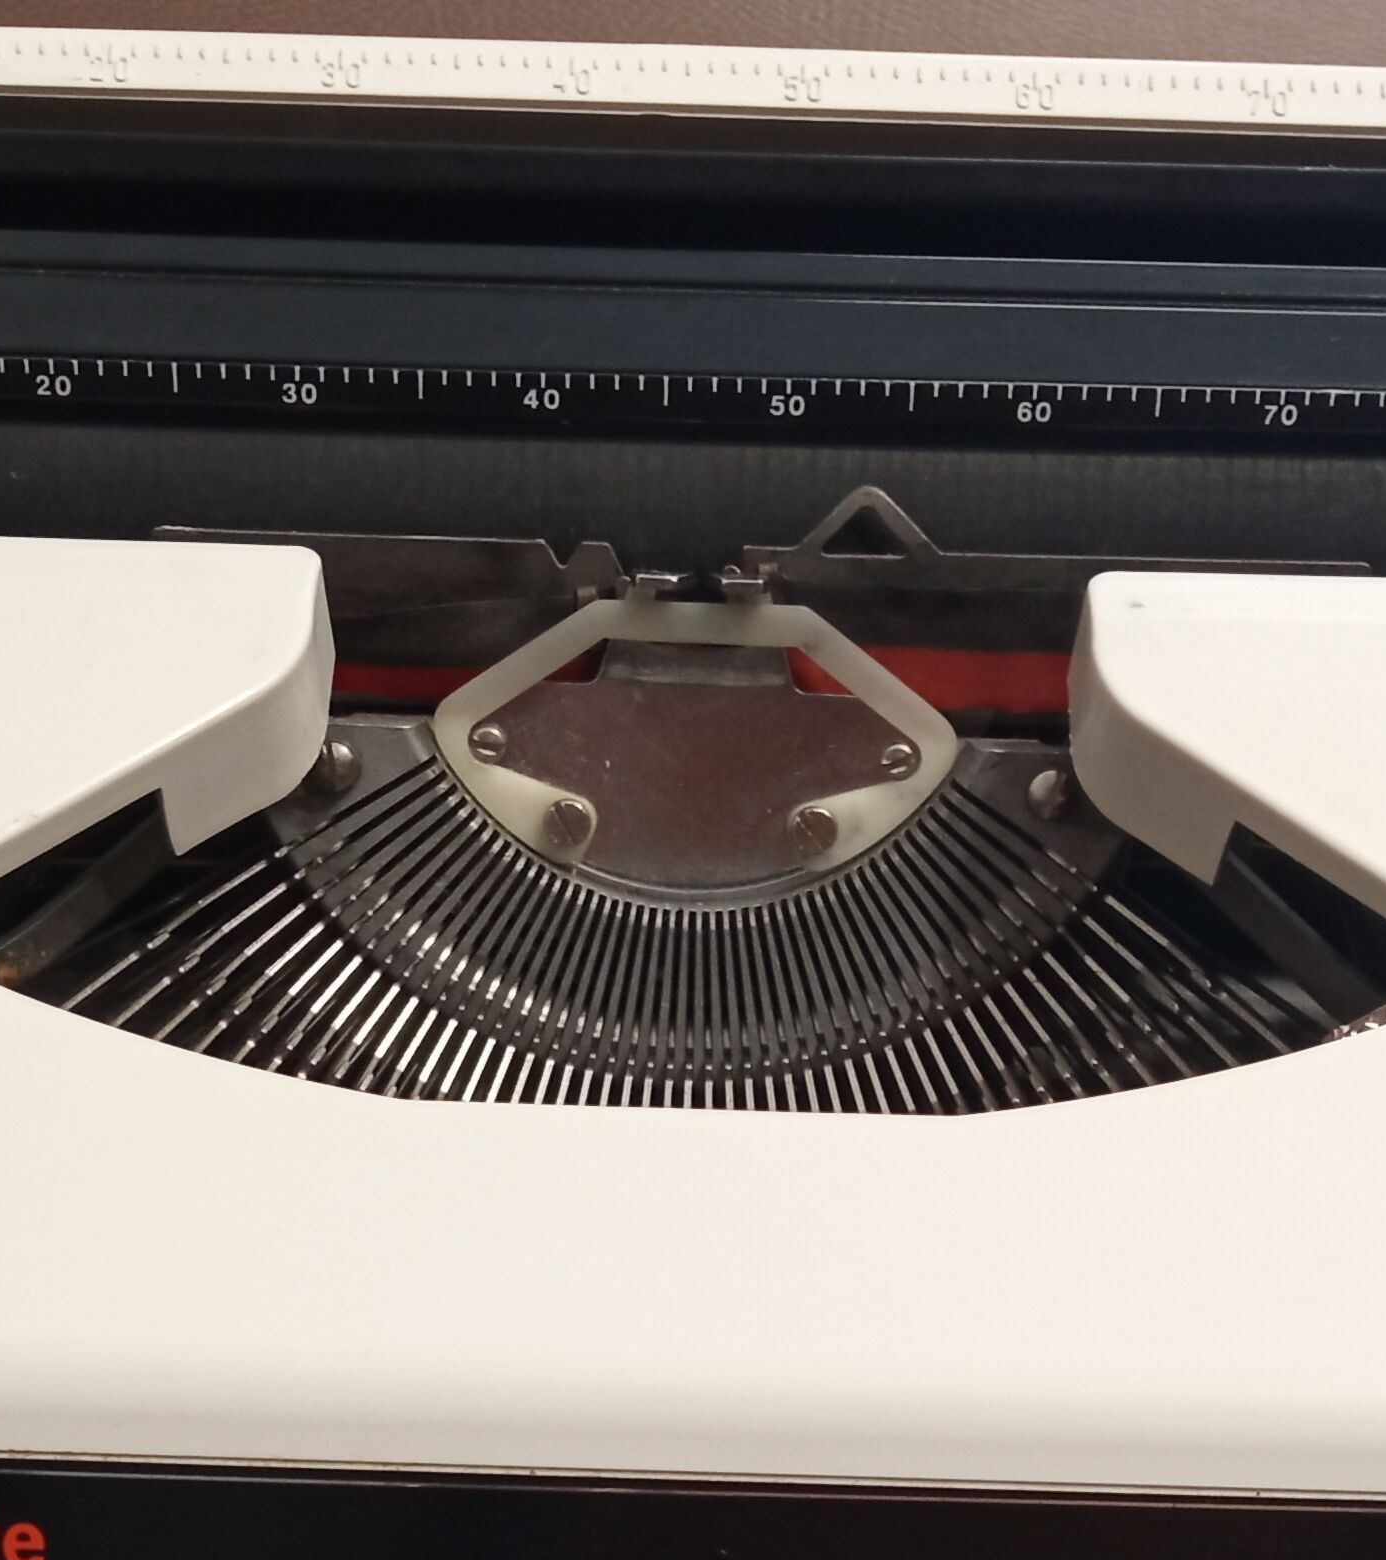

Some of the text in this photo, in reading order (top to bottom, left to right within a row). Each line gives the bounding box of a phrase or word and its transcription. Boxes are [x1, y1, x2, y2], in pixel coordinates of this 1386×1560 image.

[321, 62, 361, 88] 30
[784, 76, 821, 102] 50
[1015, 84, 1054, 110] 60
[1247, 90, 1287, 117] 70
[37, 376, 70, 395] 20
[283, 384, 316, 404] 30
[524, 390, 559, 409] 40
[770, 396, 804, 415] 50
[1018, 402, 1051, 422] 60
[1265, 405, 1297, 425] 70
